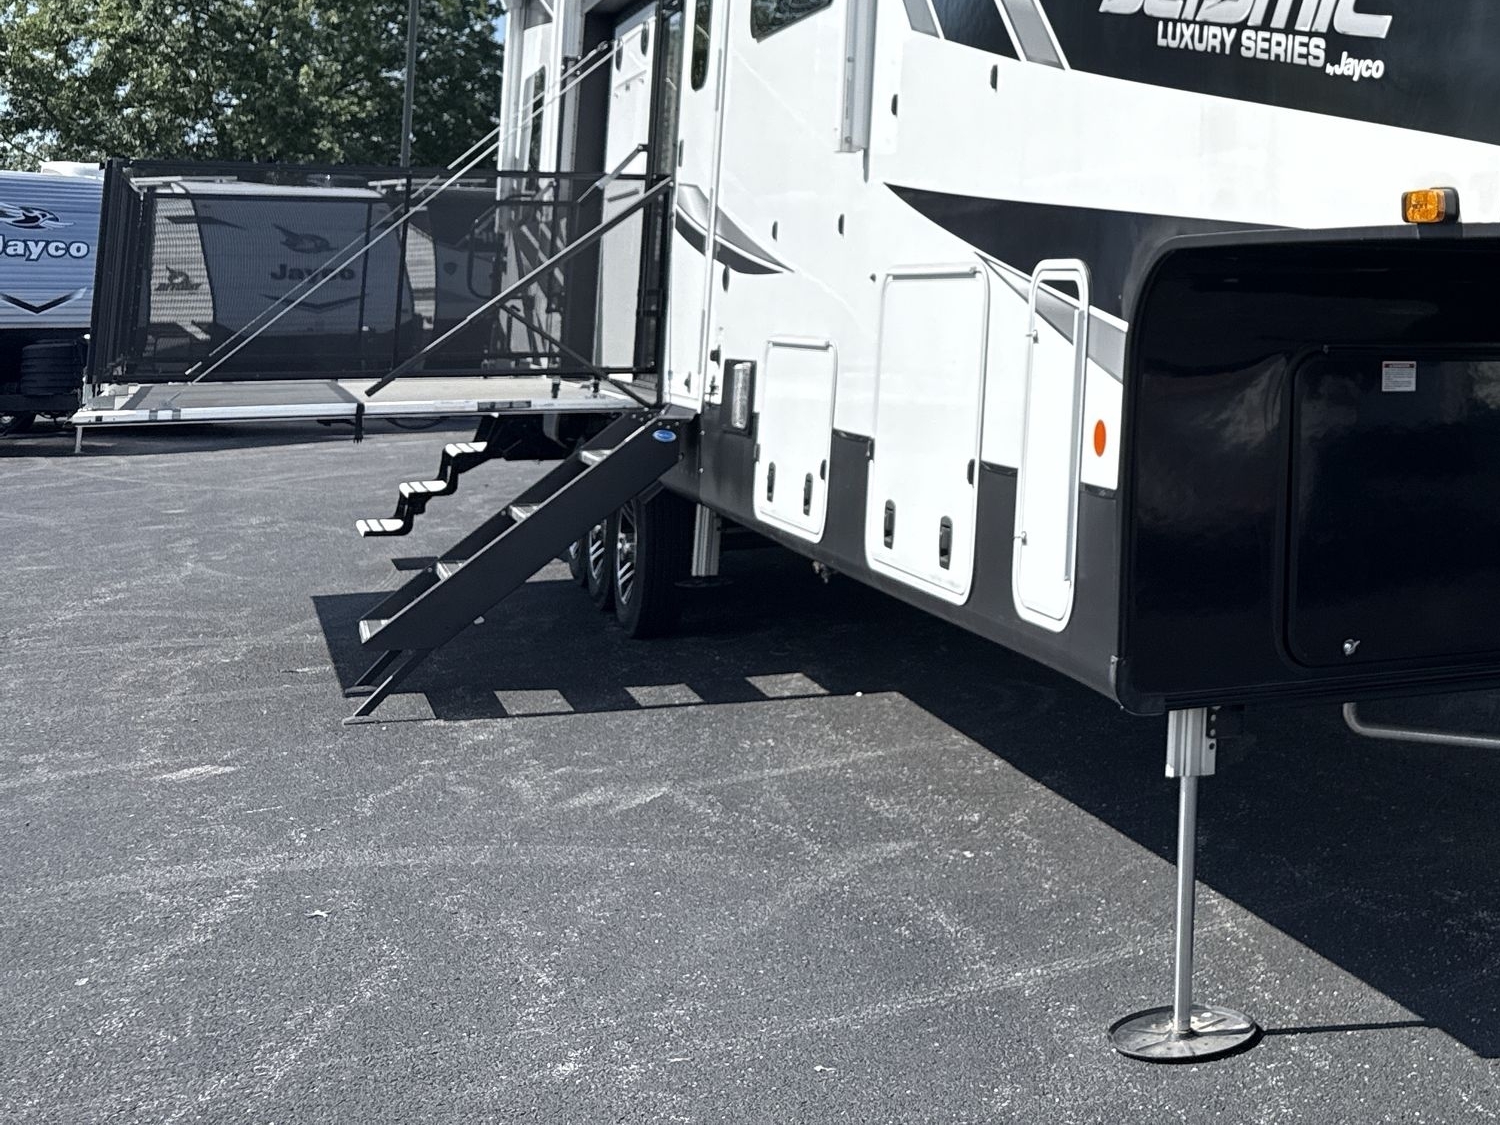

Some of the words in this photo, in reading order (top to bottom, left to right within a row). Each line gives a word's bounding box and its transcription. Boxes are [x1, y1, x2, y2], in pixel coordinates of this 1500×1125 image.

[1157, 21, 1237, 55] LUXURY
[1240, 28, 1326, 68] SERIES
[1333, 50, 1385, 82] Jayco
